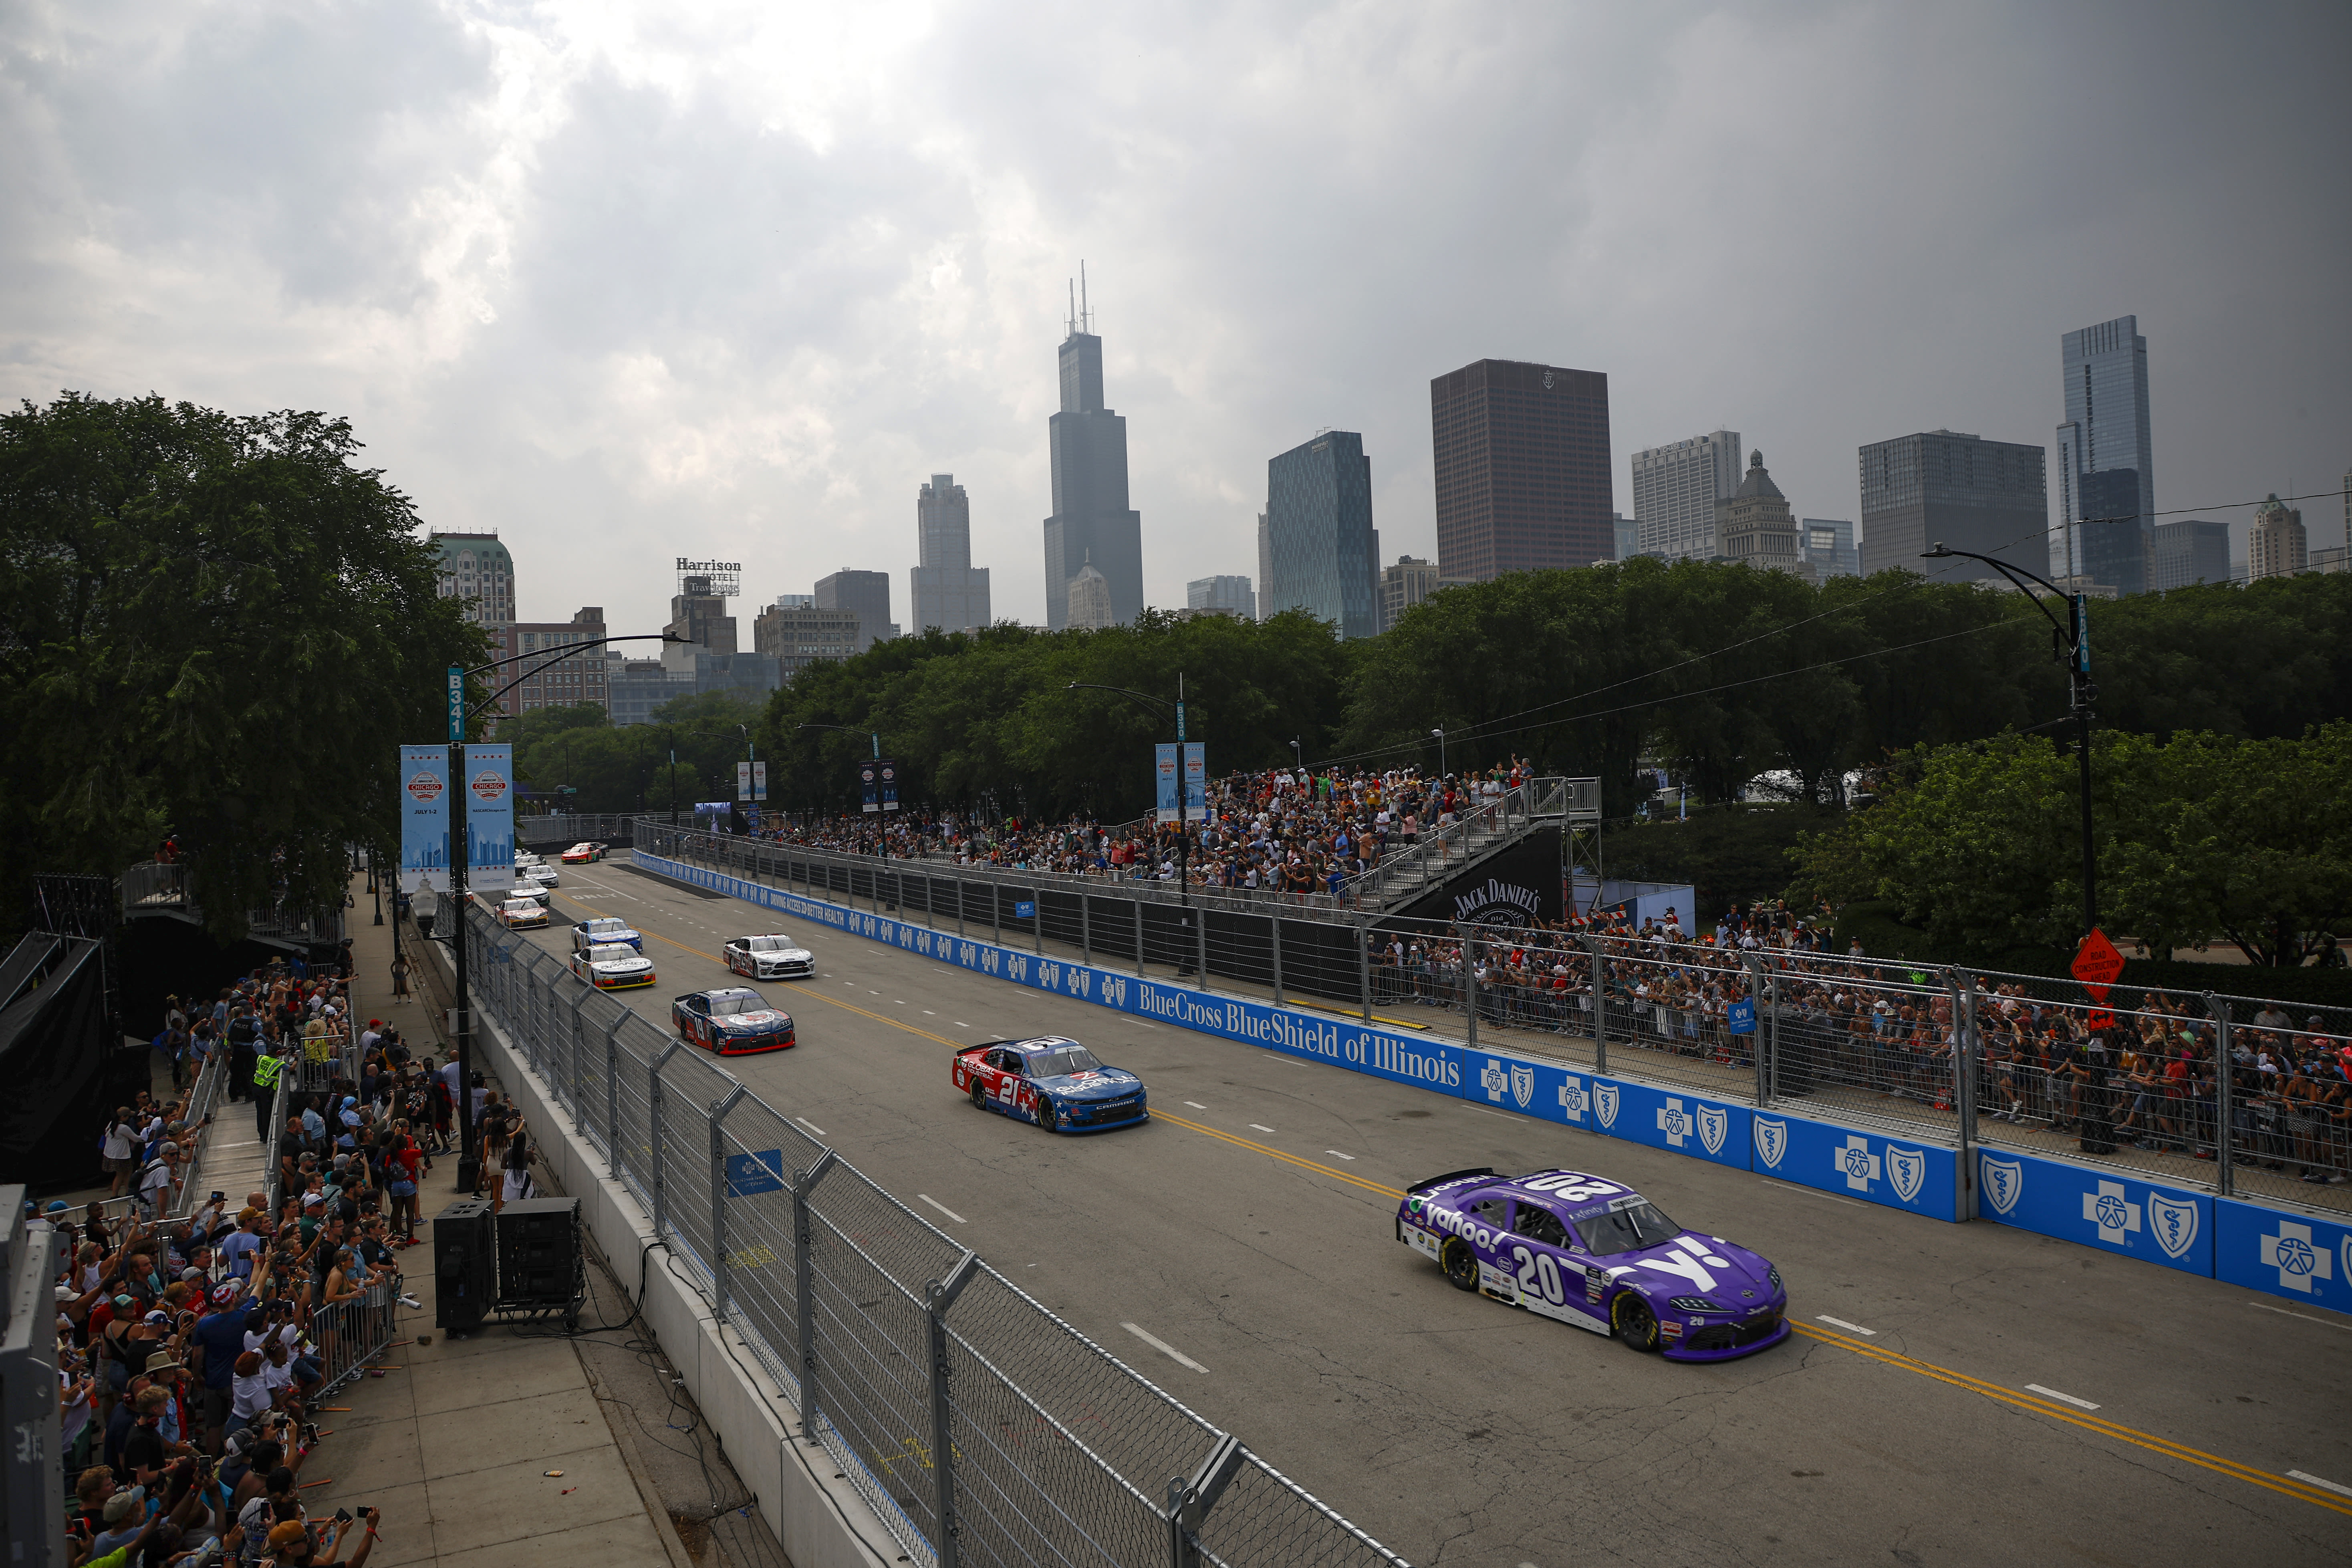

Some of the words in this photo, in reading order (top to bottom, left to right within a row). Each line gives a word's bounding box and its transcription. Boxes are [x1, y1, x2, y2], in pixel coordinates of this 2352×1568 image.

[676, 558, 741, 570] Harrison
[689, 582, 738, 592] Travelodge
[449, 675, 462, 733] B341
[1454, 886, 1489, 920] JACK
[1488, 879, 1542, 913] DANIEL'S
[771, 893, 786, 909] DRIVING
[786, 897, 801, 913] ACCESS
[807, 903, 824, 920] BETTER
[824, 908, 844, 926] HEALTH
[2090, 950, 2106, 961] ROAD
[601, 961, 649, 969] BRANDT
[2075, 959, 2120, 974] CONSTRUCTION
[2091, 971, 2110, 982] AHEAD
[694, 1017, 705, 1040] 19
[1139, 984, 1222, 1029] BlueCross
[1225, 1003, 1339, 1058] BlueShield
[1345, 1033, 1370, 1064] of
[1373, 1036, 1459, 1087] Illinois
[967, 1067, 994, 1081] INDUSTRIAL
[968, 1061, 994, 1075] GLOBAL
[999, 1076, 1020, 1106] 21
[1056, 1076, 1136, 1092] GLOBAL
[1061, 1079, 1140, 1095] INDUSTRIAL
[1096, 1099, 1135, 1110] CAMARO
[1524, 1175, 1623, 1202] 20
[1576, 1207, 1603, 1219] xfinity
[1427, 1203, 1508, 1254] yahoo!
[1513, 1246, 1564, 1304] 20
[1618, 1280, 1652, 1296] GOODYEAR
[1690, 1316, 1705, 1326] 20
